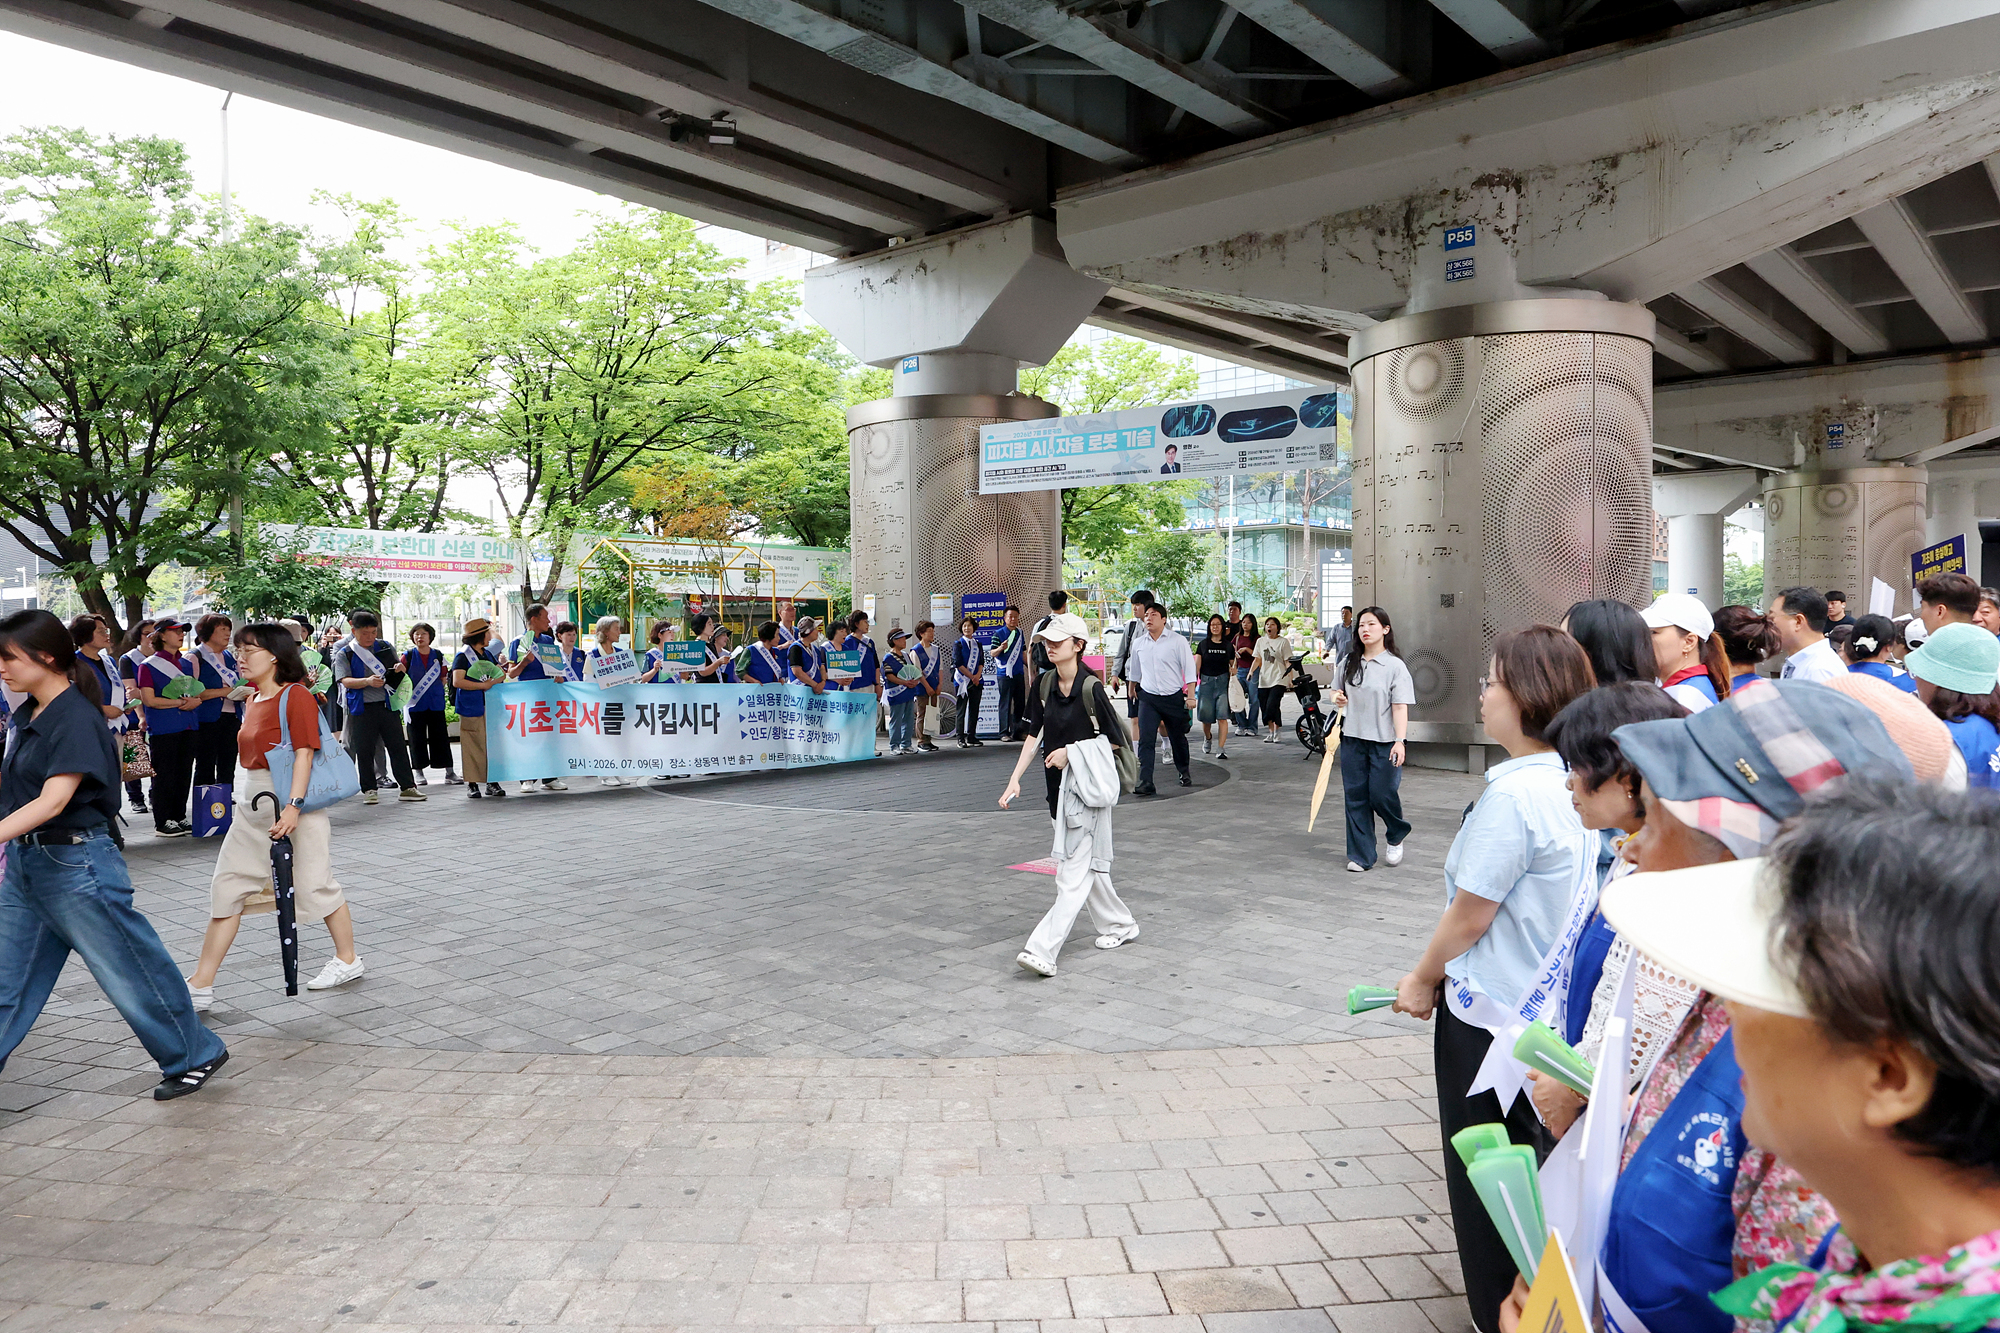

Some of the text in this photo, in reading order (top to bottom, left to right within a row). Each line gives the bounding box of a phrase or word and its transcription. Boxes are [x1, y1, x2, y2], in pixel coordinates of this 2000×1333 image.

[1447, 229, 1473, 245] P55
[904, 359, 917, 369] P26
[1828, 425, 1843, 433] P54
[987, 441, 1027, 461] 피지컬
[1030, 440, 1047, 457] AI
[1056, 436, 1084, 454] 자율
[1089, 433, 1118, 451] 로봇
[1122, 430, 1152, 447] 기술
[382, 535, 435, 557] 보관대
[441, 539, 476, 558] 신설
[482, 541, 514, 560] 안내
[411, 561, 429, 569] 자전거
[979, 619, 1004, 627] 설문조사
[745, 693, 782, 707] 일회용품
[806, 697, 828, 712] 올바른
[829, 702, 854, 714] 분리배출
[505, 700, 721, 737] 기초질서를 지킵시다
[747, 710, 776, 723] 쓰레기
[568, 758, 586, 769] 일시
[593, 758, 618, 770] 2026.
[620, 758, 635, 769] 07.
[637, 757, 664, 770] 09(목)
[669, 758, 687, 768] 장소
[694, 757, 720, 768] 창동역
[722, 755, 736, 766] 1번
[739, 754, 754, 765] 출구
